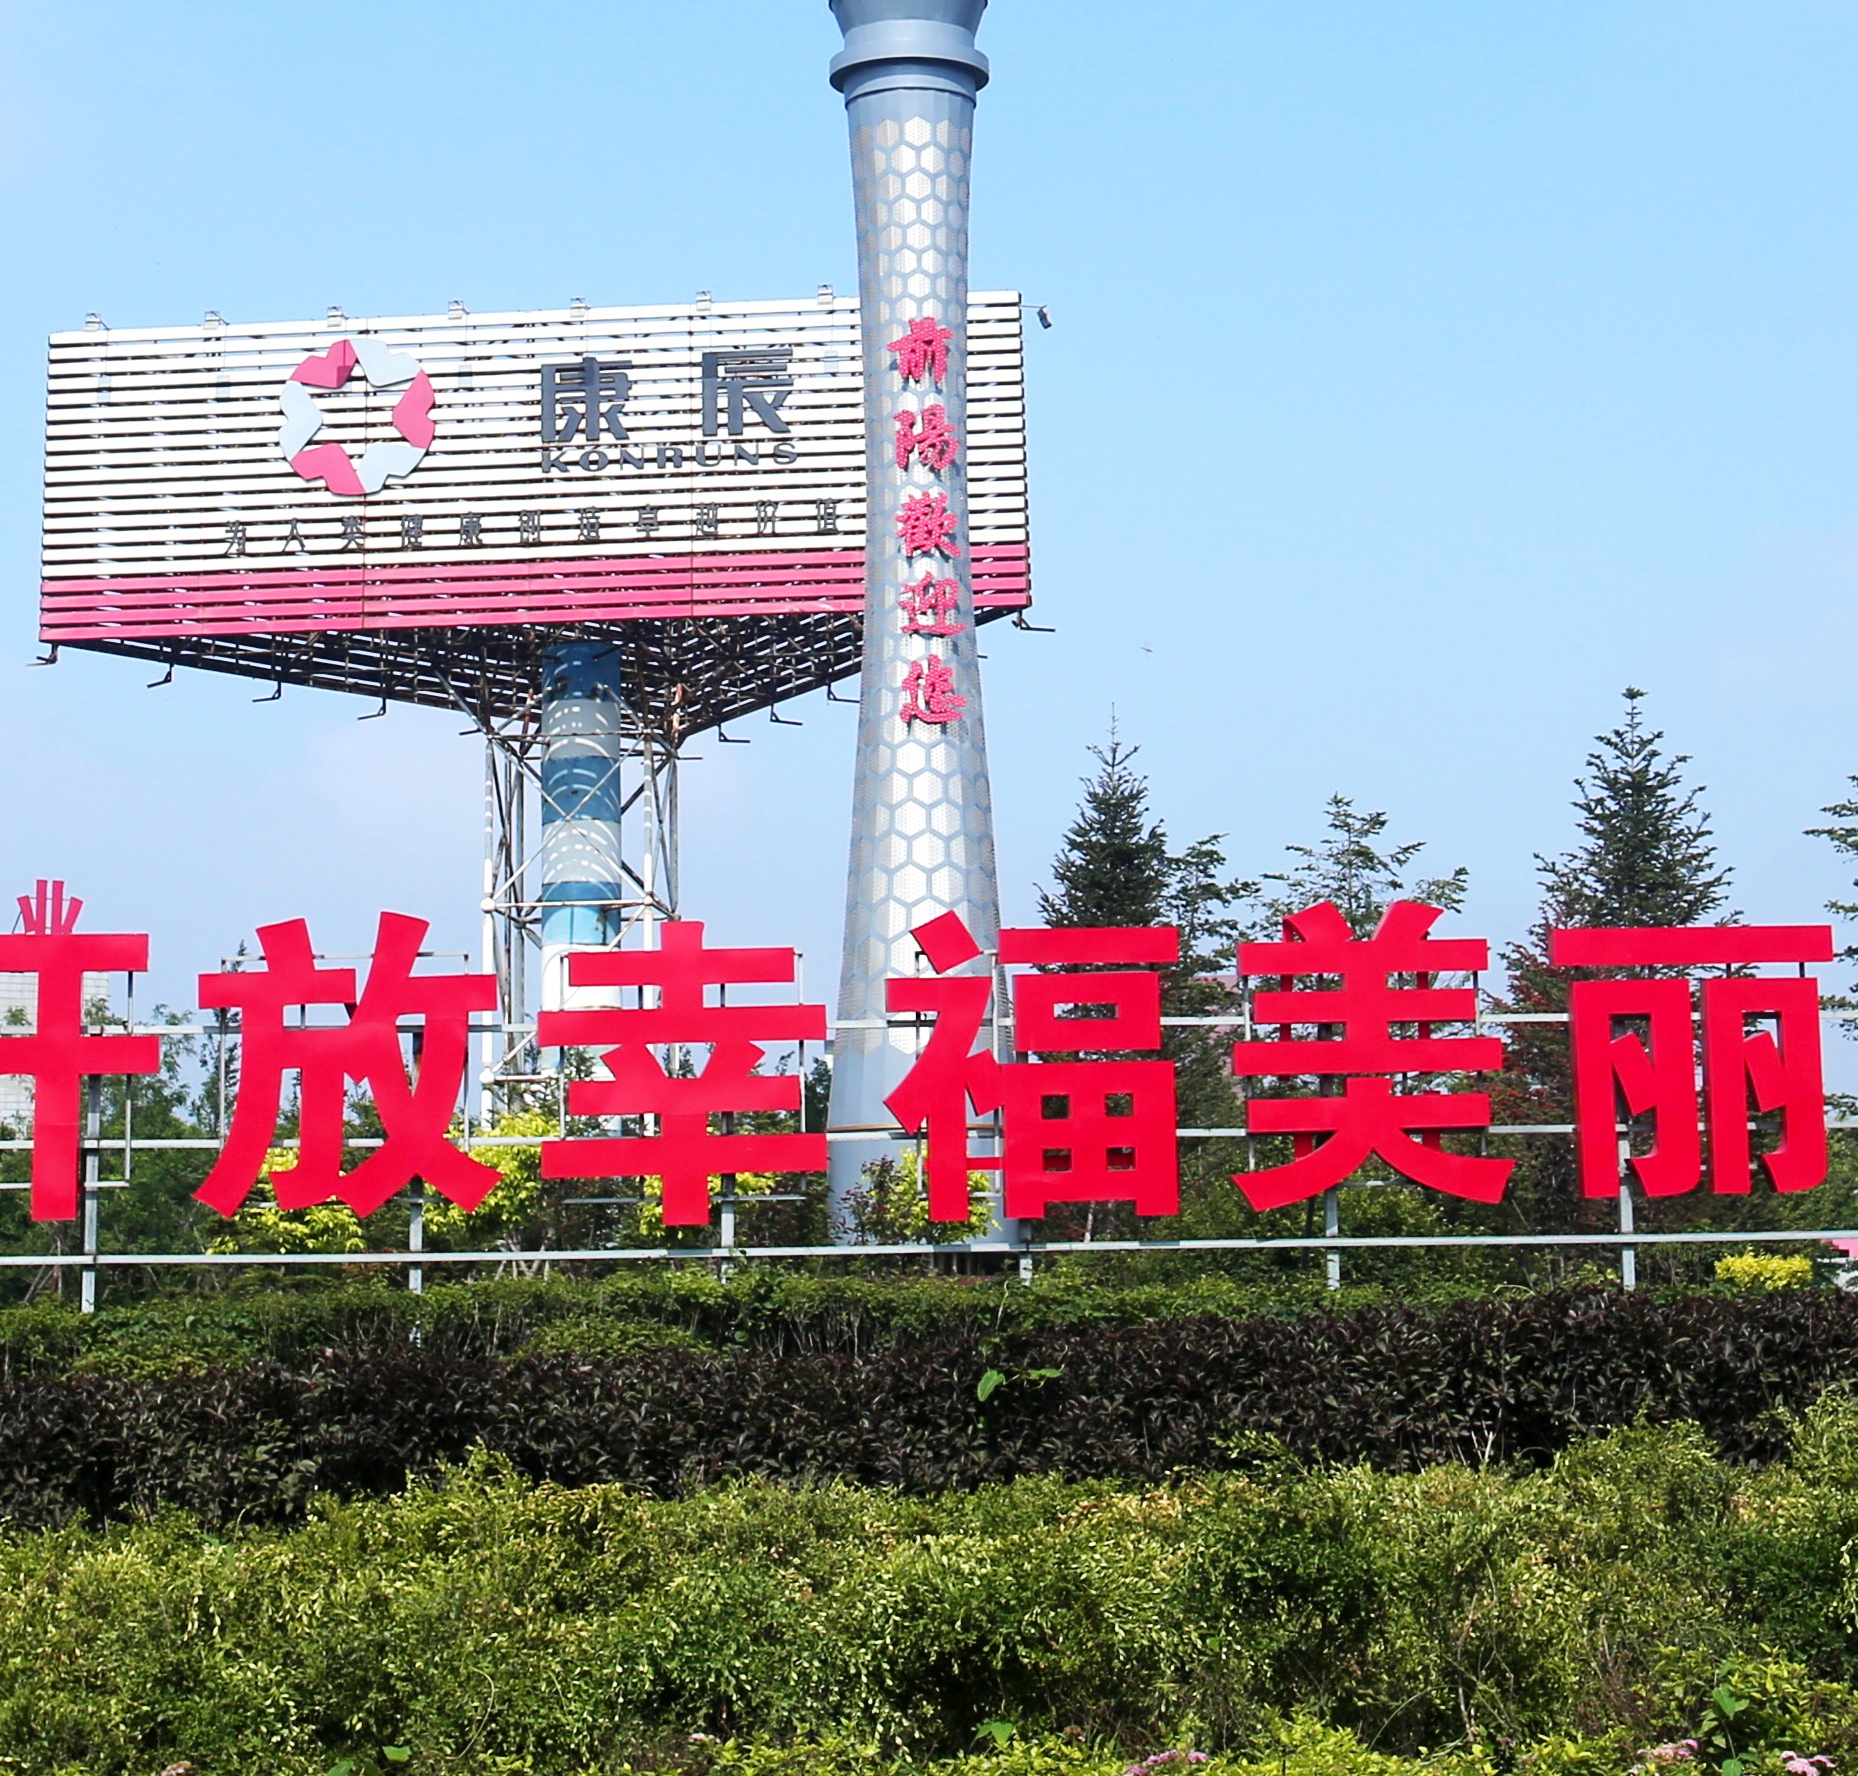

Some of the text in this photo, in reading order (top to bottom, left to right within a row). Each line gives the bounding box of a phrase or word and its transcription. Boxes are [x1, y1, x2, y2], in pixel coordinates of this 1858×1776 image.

[541, 348, 794, 443] 康辰
[542, 442, 798, 473] KONRUNS
[224, 497, 839, 557] 为人类健康创造卓越价值
